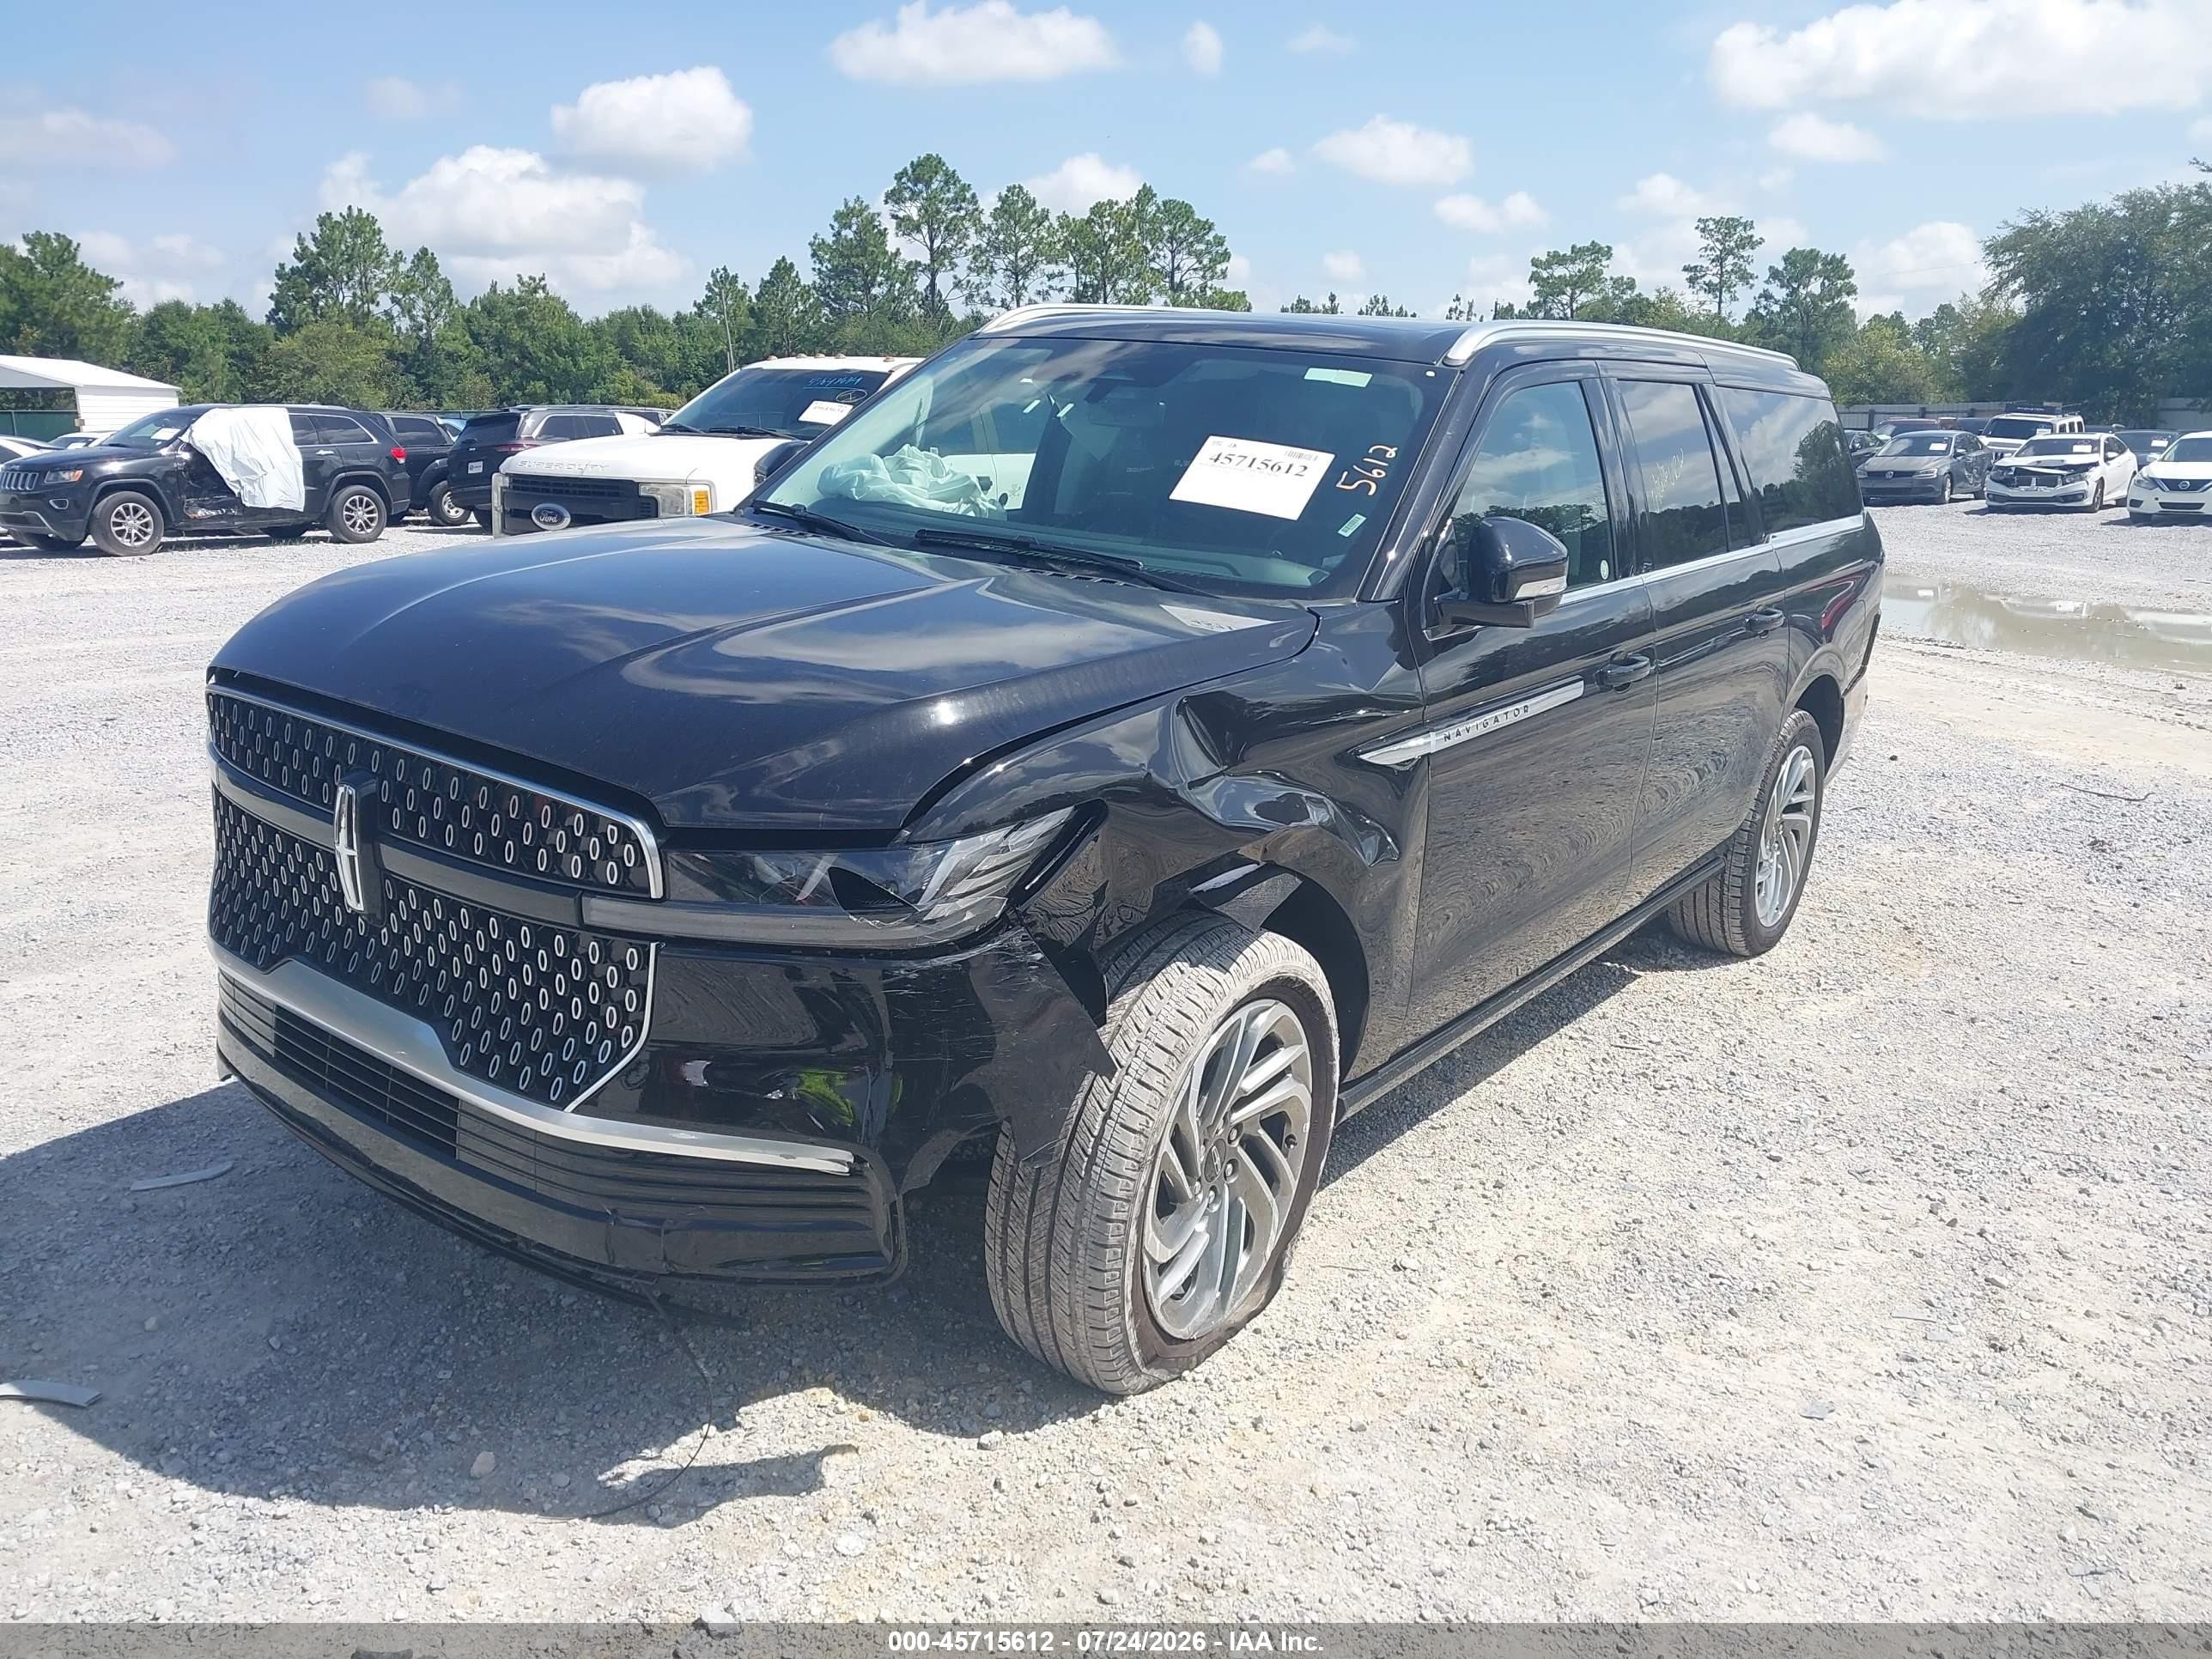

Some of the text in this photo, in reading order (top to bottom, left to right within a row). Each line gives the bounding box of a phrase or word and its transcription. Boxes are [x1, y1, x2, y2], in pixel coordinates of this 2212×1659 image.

[518, 459, 610, 472] SUPER DUTY
[1209, 452, 1309, 477] 45715612
[1335, 444, 1398, 495] 5612
[538, 508, 558, 523] Ford
[1443, 704, 1529, 742] NAVIGATOR
